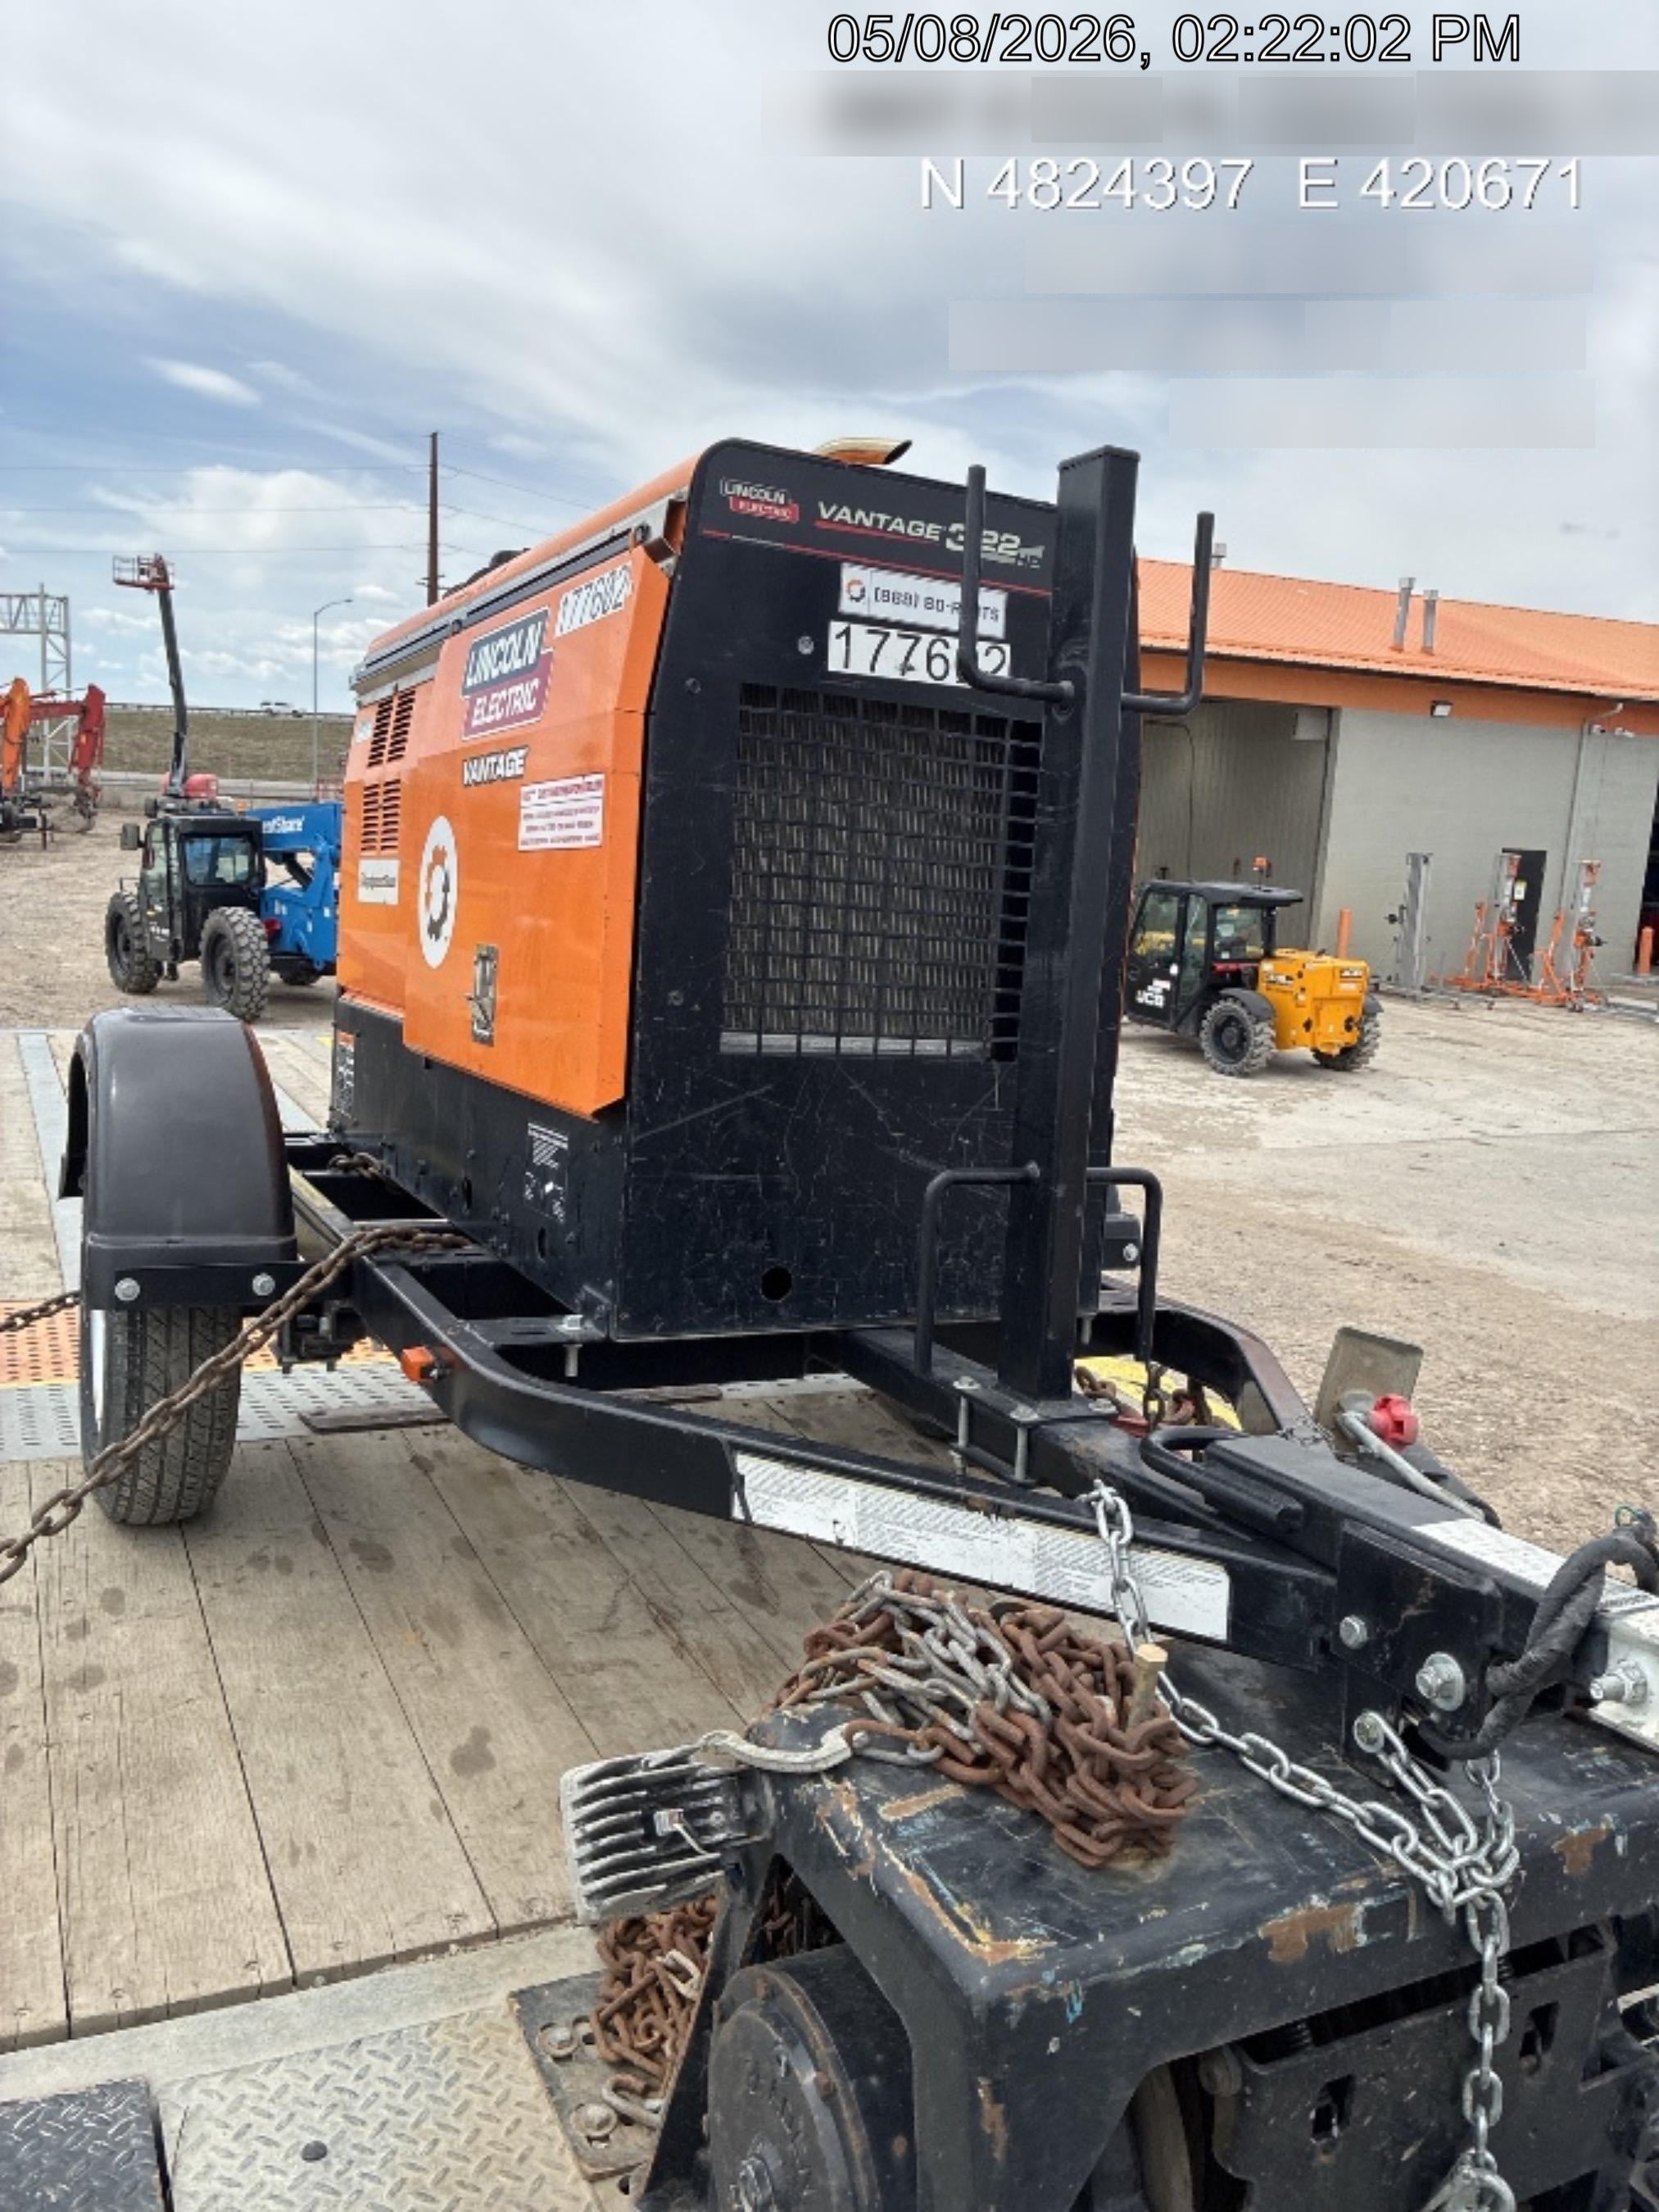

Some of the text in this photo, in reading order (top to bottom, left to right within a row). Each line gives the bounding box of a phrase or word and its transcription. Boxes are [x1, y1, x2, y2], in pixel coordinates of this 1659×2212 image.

[723, 480, 786, 505] LINCOLN
[818, 500, 1022, 557] VANTAGE 322
[923, 596, 1000, 623] 80-RTS
[465, 621, 542, 687] LINCOLN
[835, 624, 1007, 683] 17762
[470, 678, 540, 728] ELECTRIC
[463, 746, 527, 786] VANTAGE
